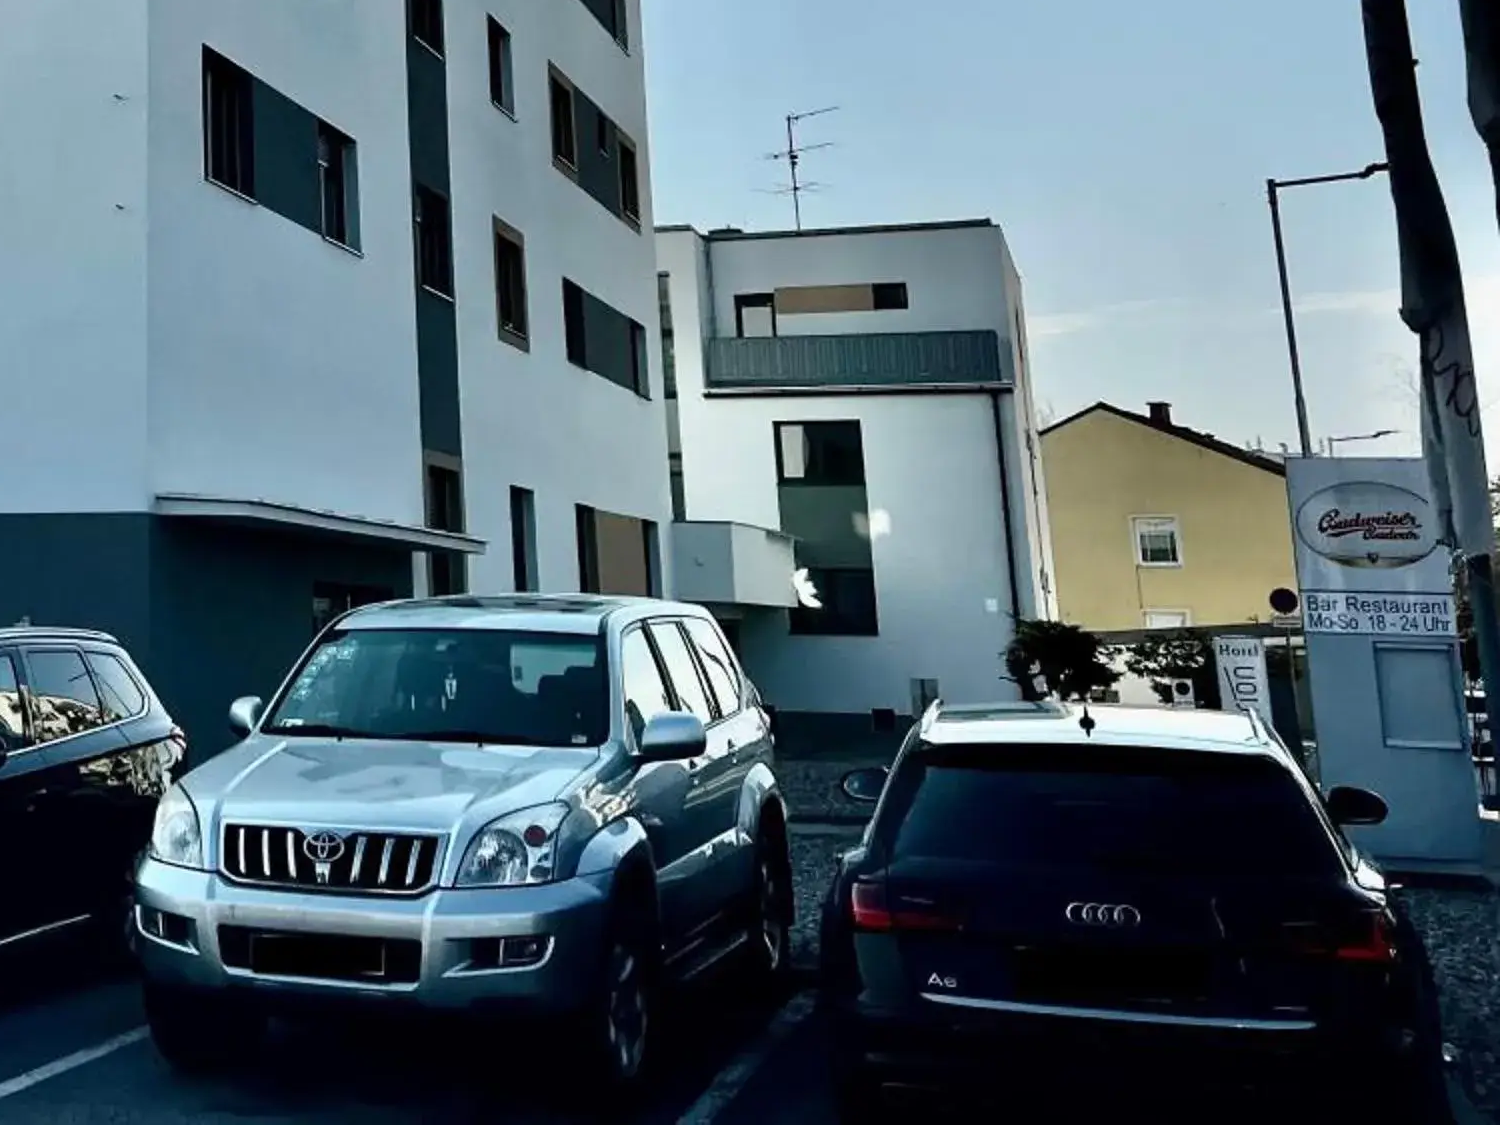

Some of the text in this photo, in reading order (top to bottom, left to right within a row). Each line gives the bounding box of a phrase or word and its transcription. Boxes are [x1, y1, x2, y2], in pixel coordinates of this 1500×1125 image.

[1307, 595, 1448, 616] Bar Restaurant
[1368, 615, 1387, 631] 18
[1399, 616, 1420, 632] 24
[1423, 617, 1451, 632] Uhr
[927, 972, 957, 988] A6
